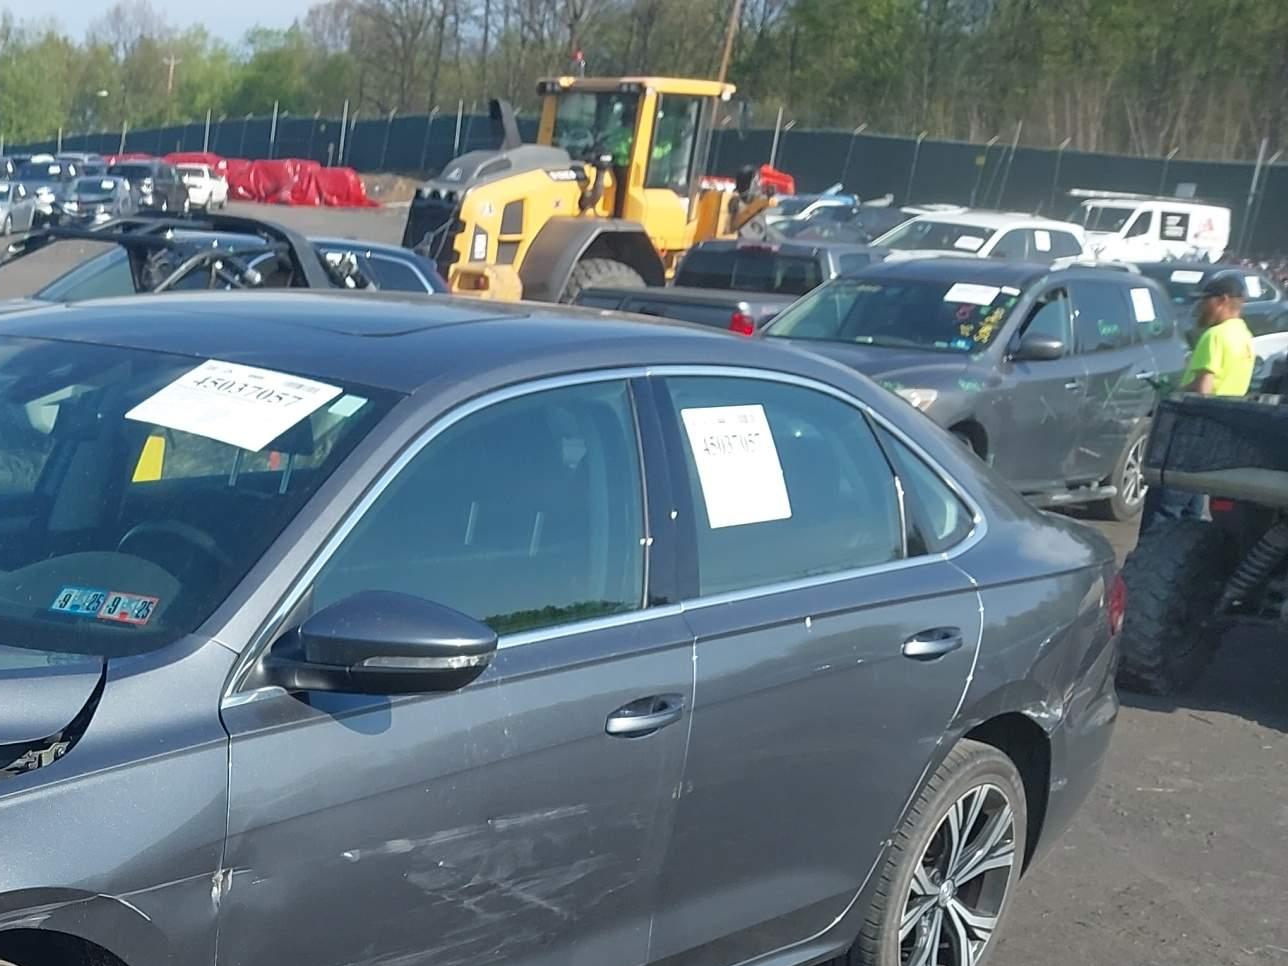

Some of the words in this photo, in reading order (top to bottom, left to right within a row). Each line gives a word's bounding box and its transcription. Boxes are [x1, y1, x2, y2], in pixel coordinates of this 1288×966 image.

[193, 375, 304, 407] 45037057
[86, 593, 105, 611] 25
[135, 600, 154, 619] 25
